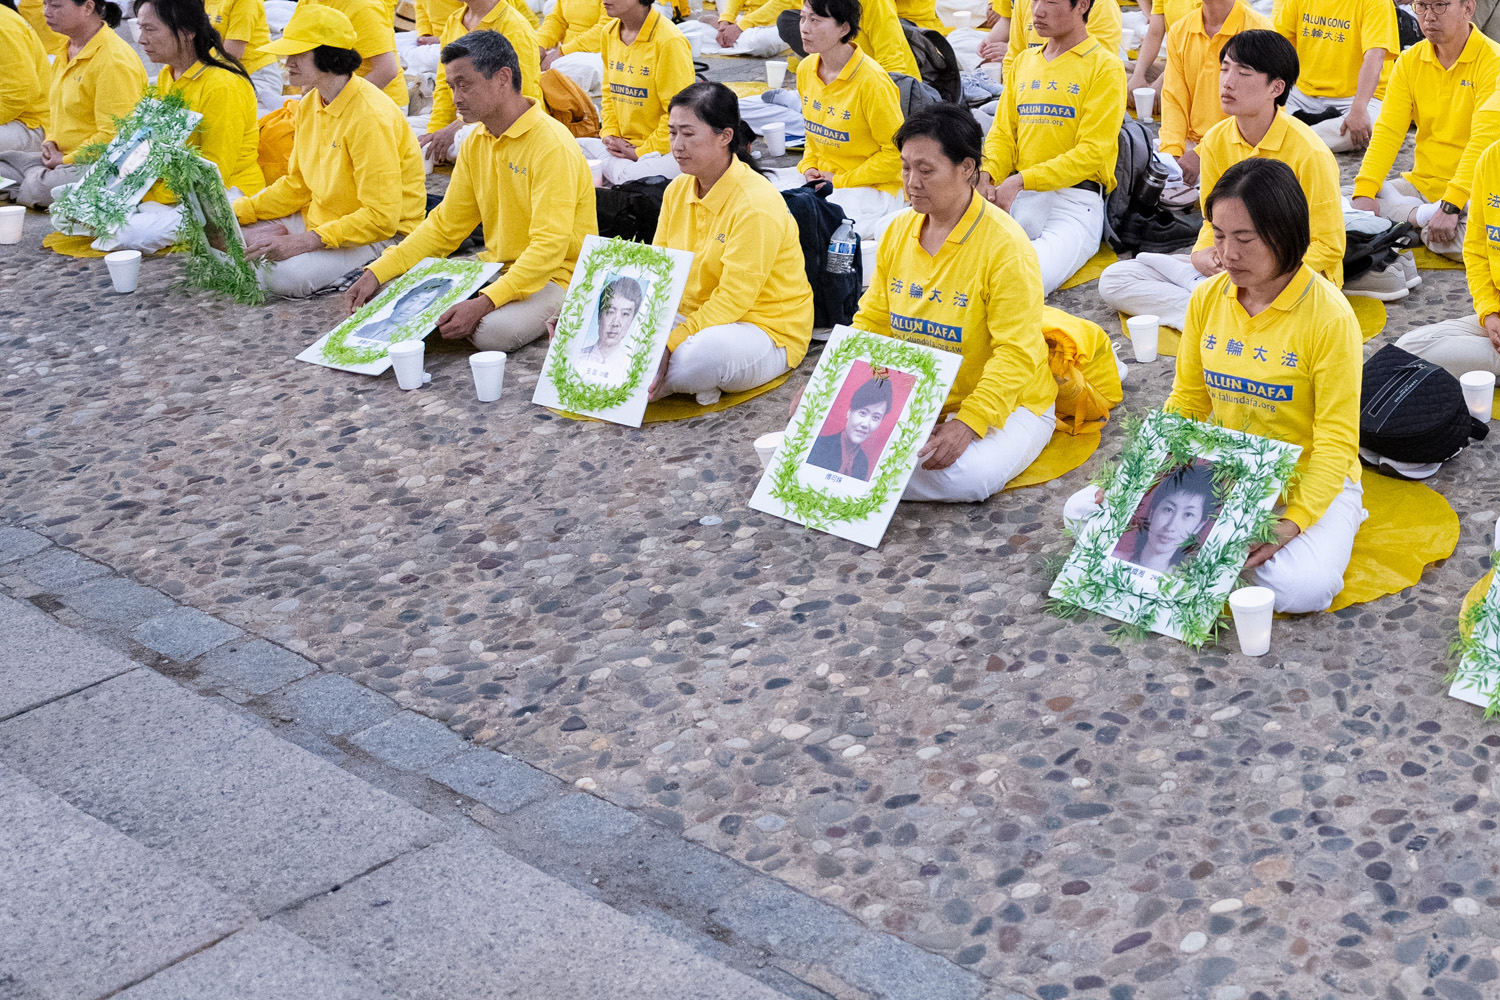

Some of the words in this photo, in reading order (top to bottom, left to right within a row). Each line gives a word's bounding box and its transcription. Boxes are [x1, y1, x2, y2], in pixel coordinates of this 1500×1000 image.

[1302, 13, 1326, 26] FALUN
[1044, 106, 1072, 116] DAFA
[824, 128, 846, 140] DAFA
[890, 277, 969, 308] 法輪大法
[927, 323, 958, 340] DAFA
[1203, 333, 1298, 368] 法輪大法
[1247, 383, 1288, 399] DAFA
